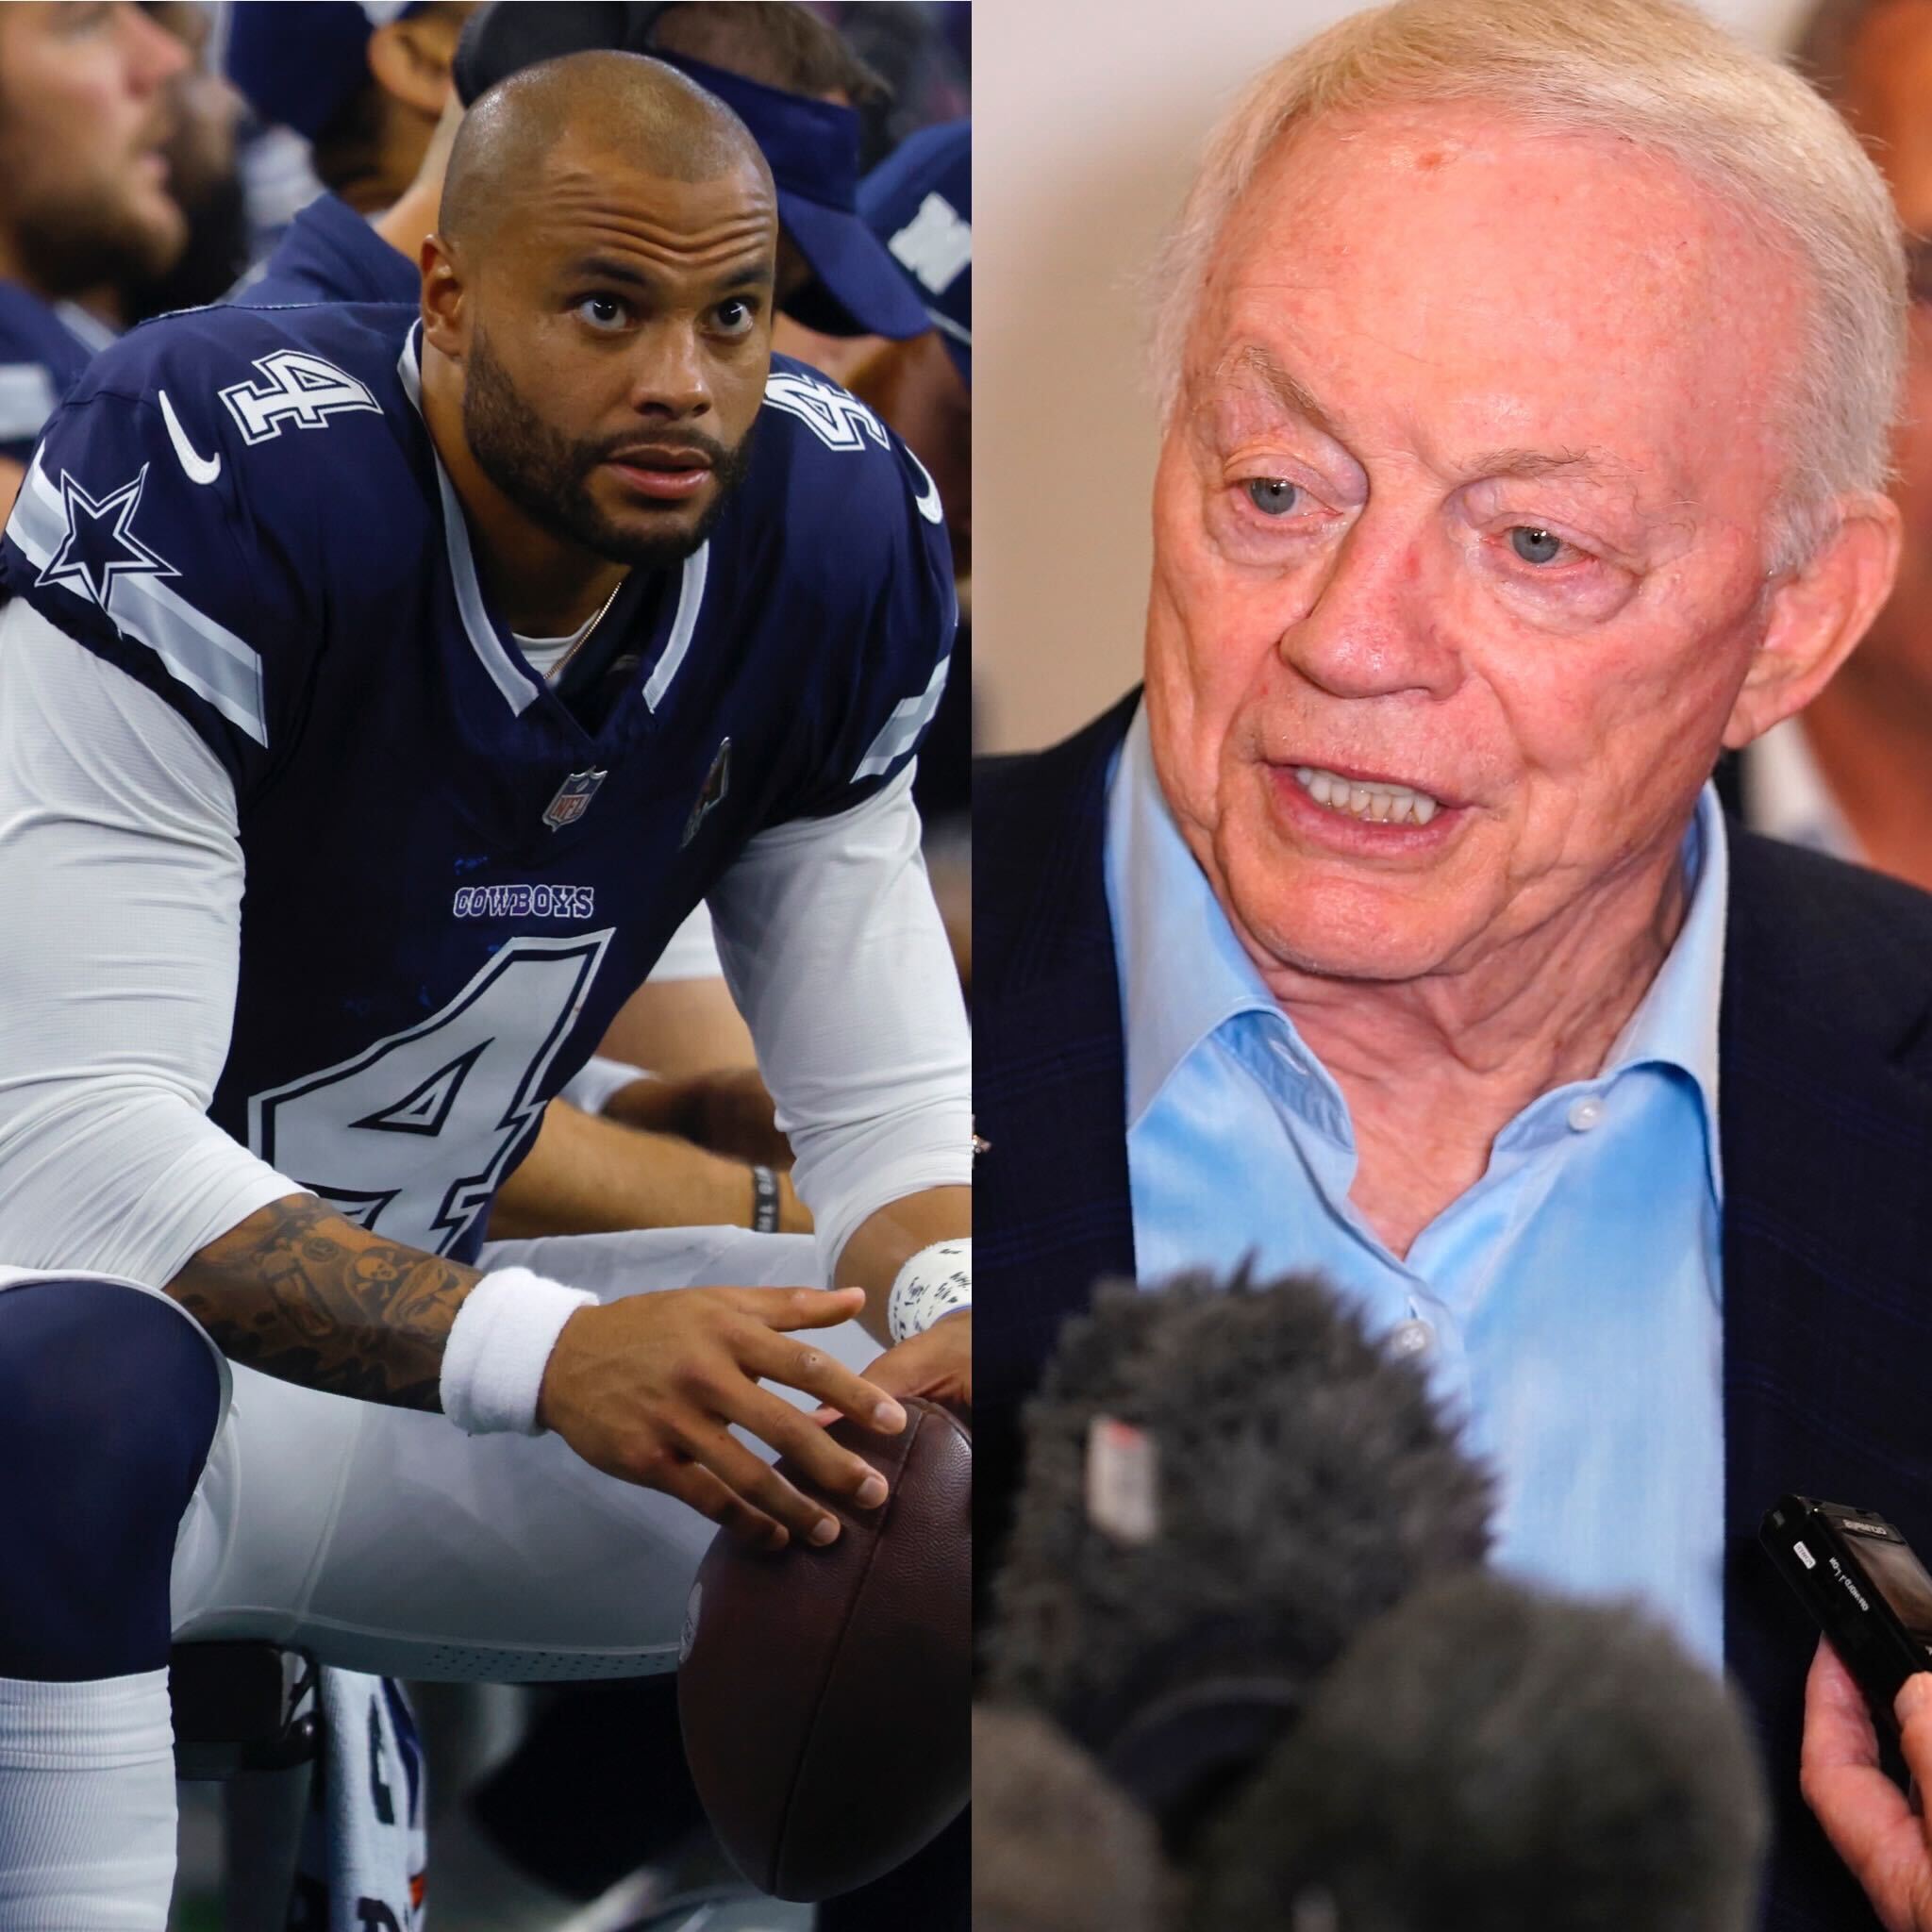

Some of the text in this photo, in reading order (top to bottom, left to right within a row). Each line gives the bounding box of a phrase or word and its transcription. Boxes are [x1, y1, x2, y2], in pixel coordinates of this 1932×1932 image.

[217, 349, 384, 446] 4
[453, 884, 594, 919] COWBOYS
[248, 926, 617, 1258] 4
